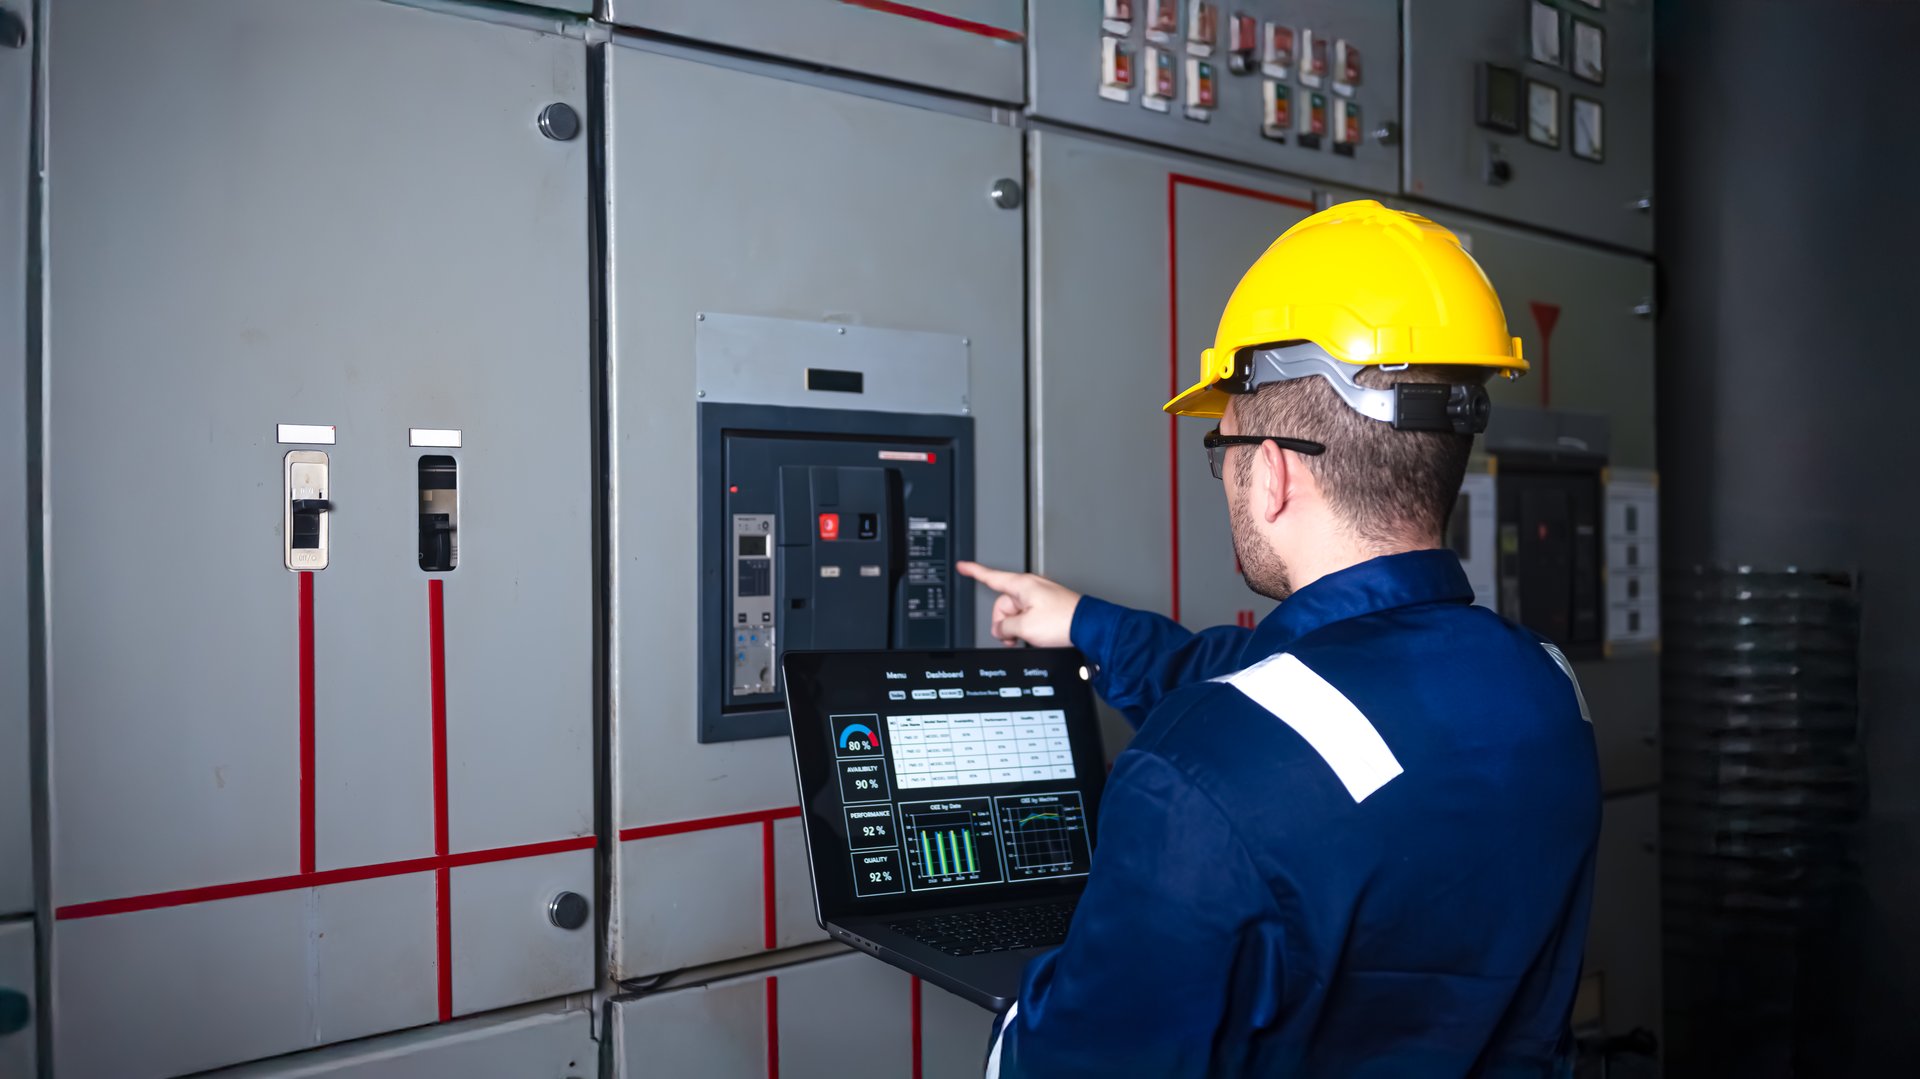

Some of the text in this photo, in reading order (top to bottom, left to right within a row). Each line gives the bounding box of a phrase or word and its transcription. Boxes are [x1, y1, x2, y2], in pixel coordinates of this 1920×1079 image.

[886, 671, 907, 679] Menu
[925, 670, 964, 679] Dashboard
[848, 740, 871, 750] 80 %
[855, 779, 878, 789] 90 %
[850, 810, 890, 818] PERFORMANCE
[863, 826, 886, 836] 92 %
[869, 872, 892, 882] 92 %
